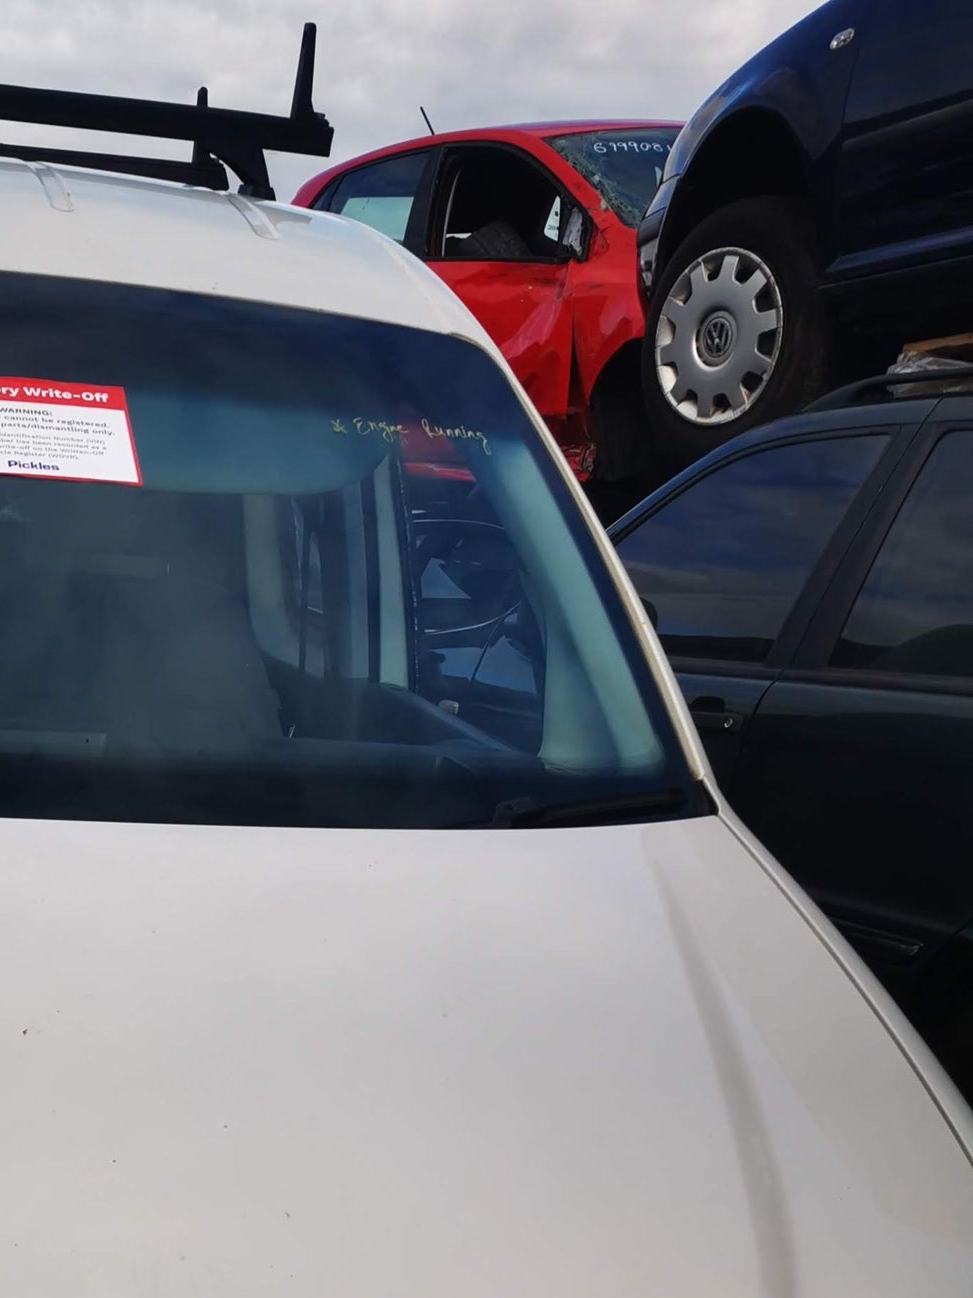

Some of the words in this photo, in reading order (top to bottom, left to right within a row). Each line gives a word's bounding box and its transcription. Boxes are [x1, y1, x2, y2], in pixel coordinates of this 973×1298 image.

[23, 386, 109, 403] Write-Off
[0, 421, 90, 434] parts/dismantling
[91, 428, 116, 437] only.
[4, 415, 39, 423] cannot
[56, 418, 110, 429] registered.
[353, 417, 409, 442] Engine
[421, 418, 492, 456] Running
[7, 459, 60, 472] Pickles
